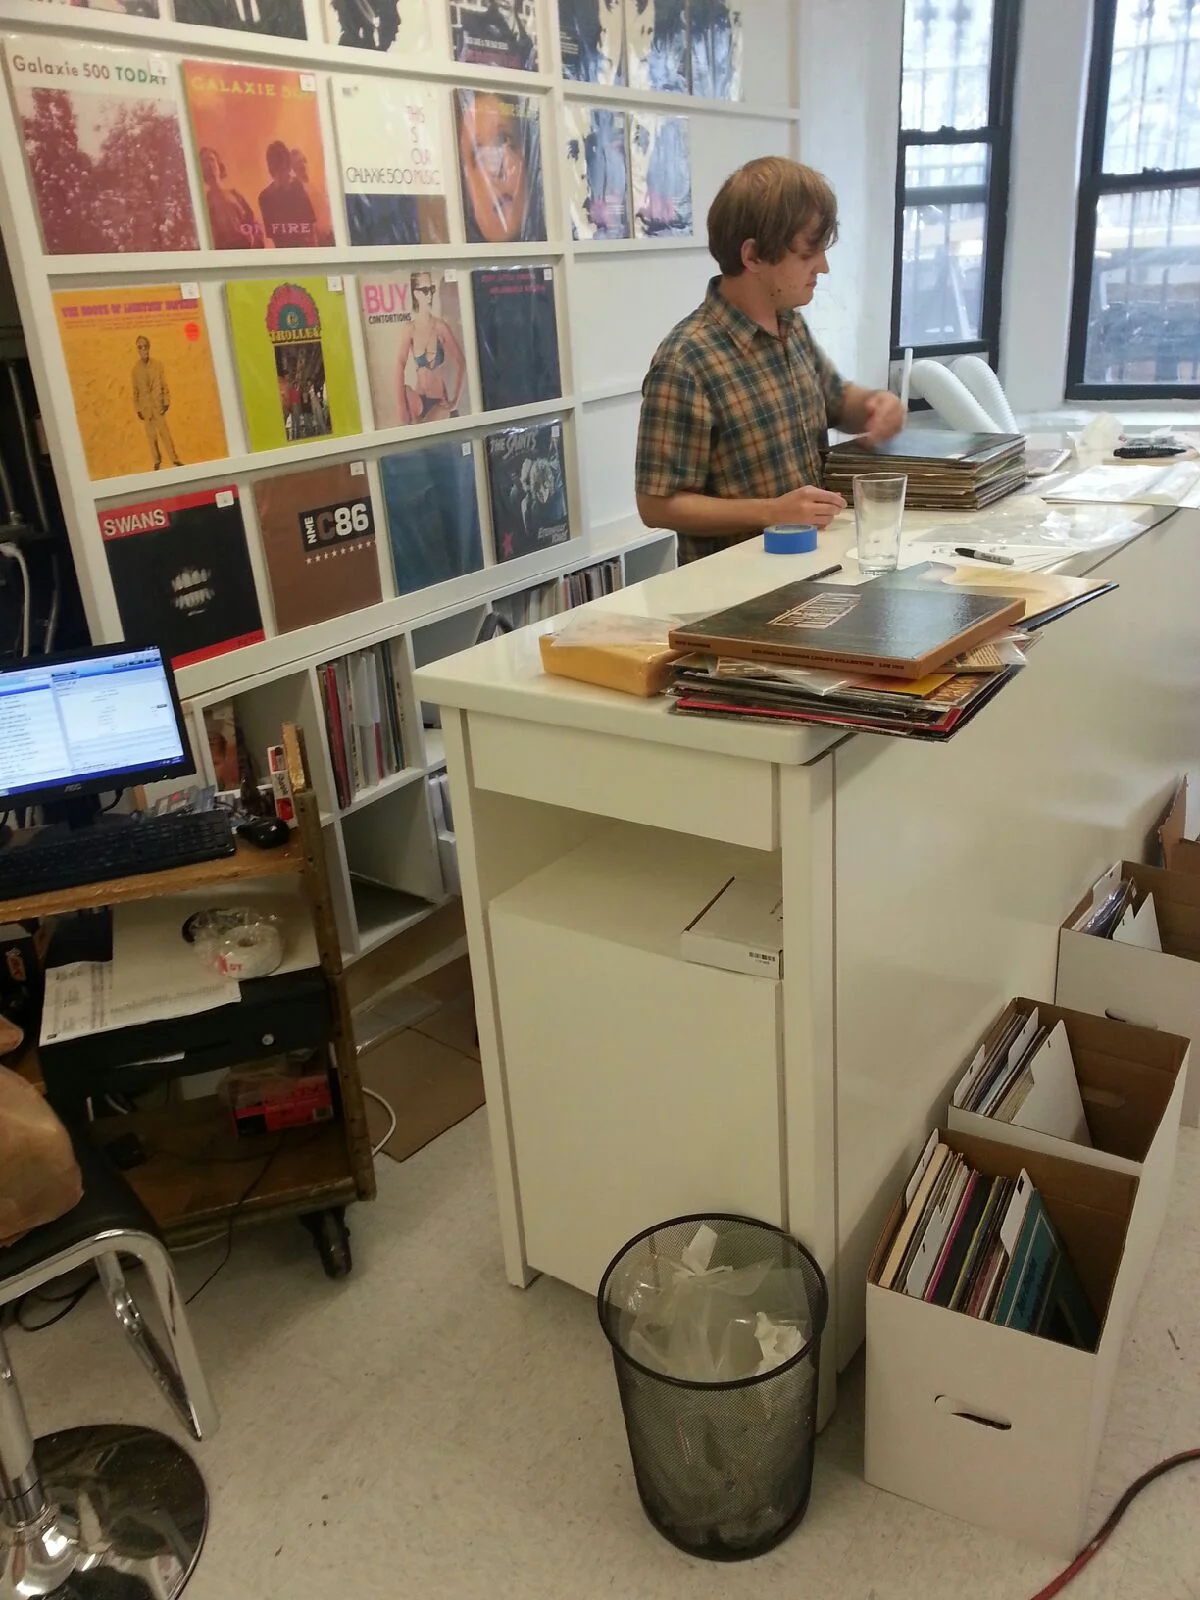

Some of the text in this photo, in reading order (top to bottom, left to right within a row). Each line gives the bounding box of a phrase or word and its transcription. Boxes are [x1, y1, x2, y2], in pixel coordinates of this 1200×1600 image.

[13, 55, 79, 77] Galaxie
[83, 63, 110, 80] 500
[191, 76, 277, 97] GALAXIE
[386, 168, 413, 185] 500
[271, 222, 311, 234] FIRE
[363, 283, 408, 314] BUY
[368, 312, 412, 325] CONTORTIONS
[103, 508, 166, 536] SWANS
[304, 516, 317, 544] NME
[317, 503, 369, 540] C86
